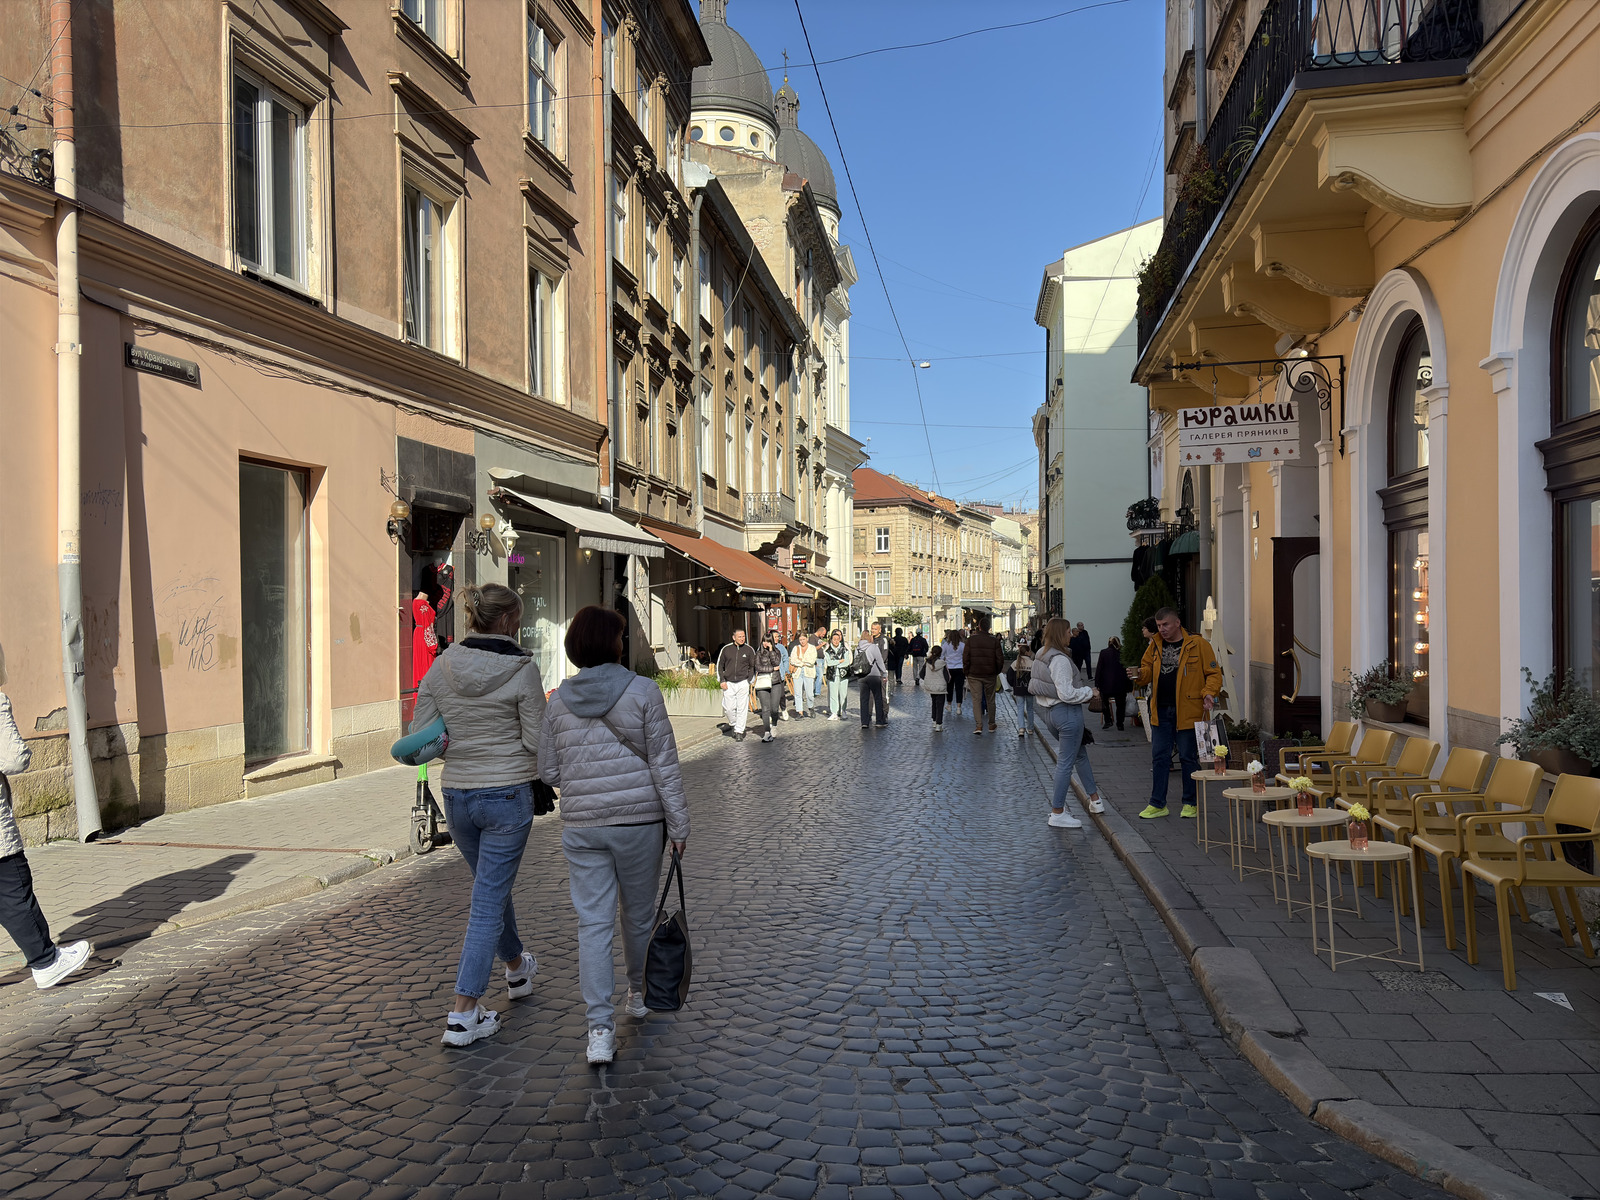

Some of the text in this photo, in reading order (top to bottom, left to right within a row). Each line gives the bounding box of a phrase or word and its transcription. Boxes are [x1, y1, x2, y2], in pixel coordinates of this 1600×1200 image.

[144, 350, 181, 369] Краківська
[1183, 403, 1294, 427] Юрашки
[1190, 428, 1289, 441] ГАЛЕРЕЯ ПРЯНИКІВ
